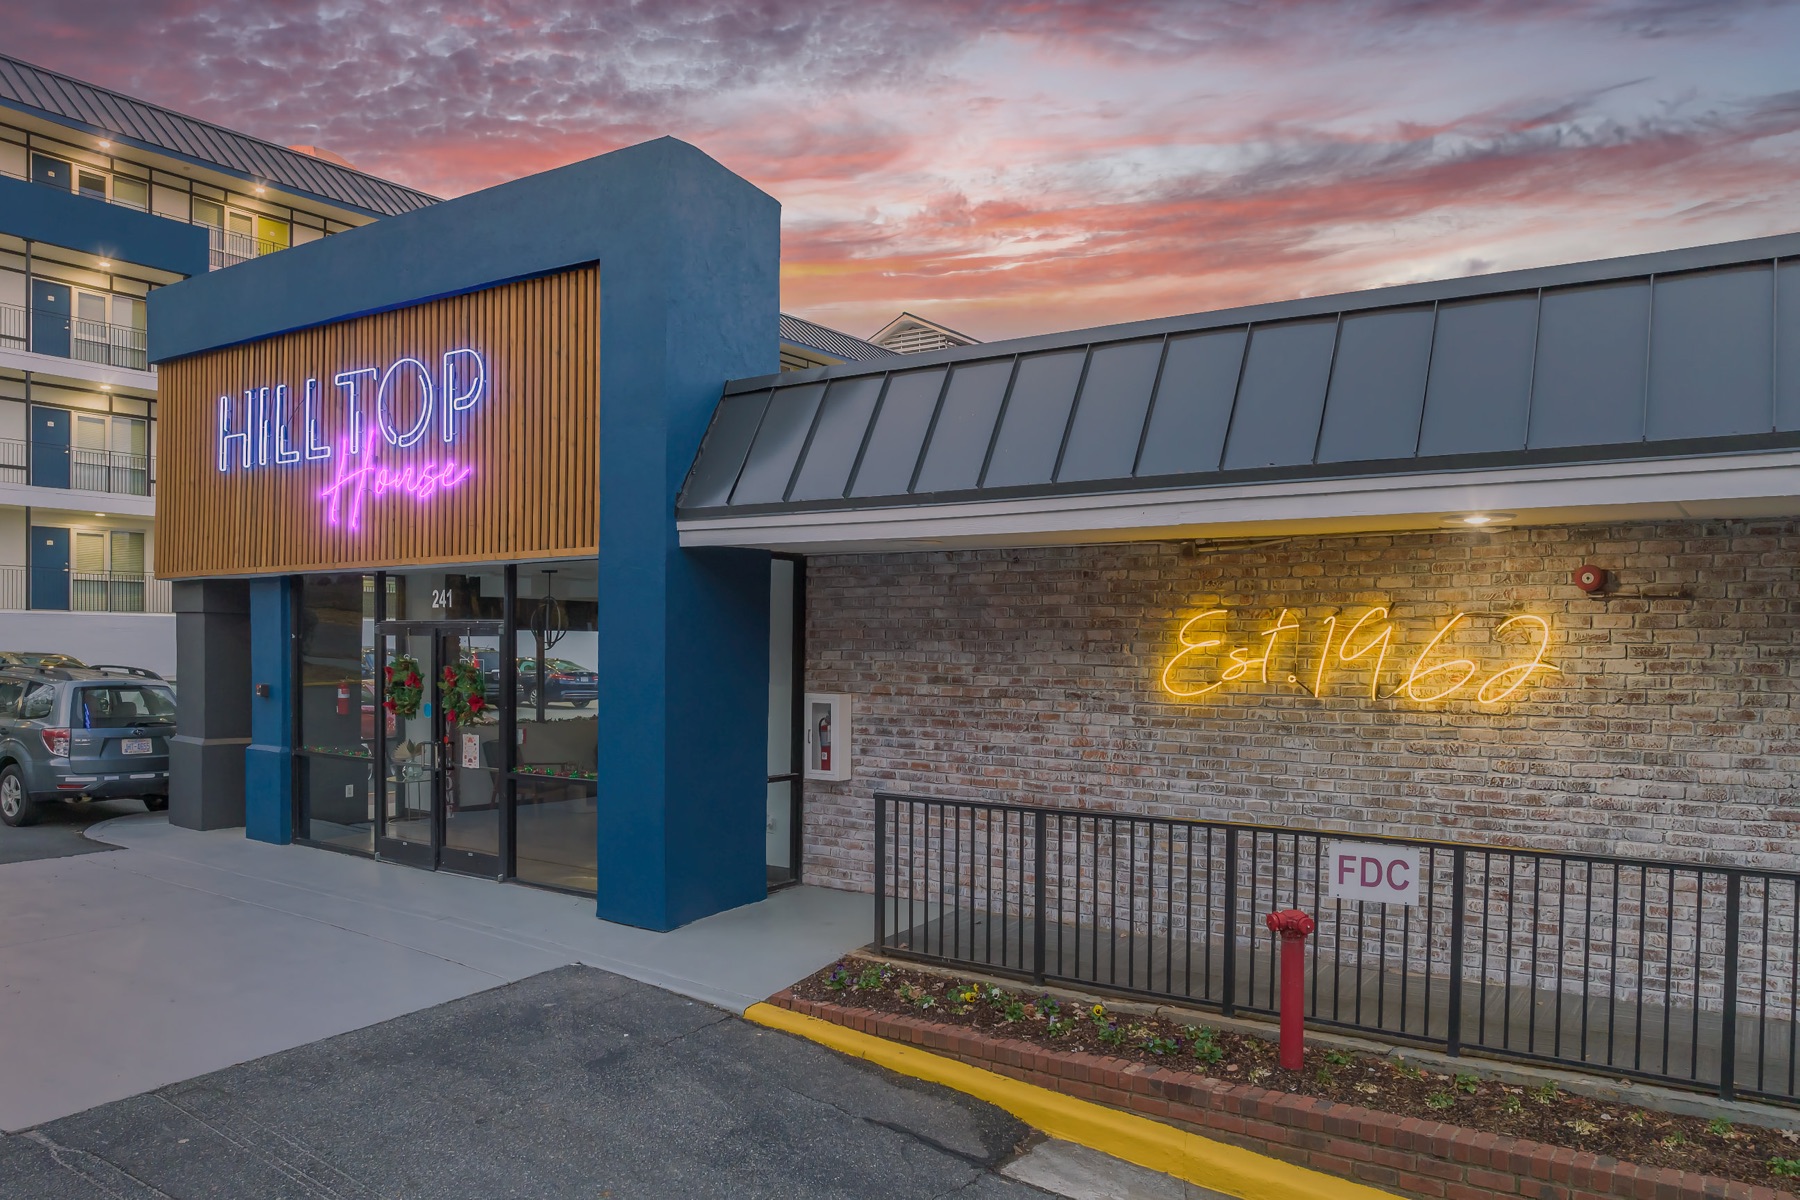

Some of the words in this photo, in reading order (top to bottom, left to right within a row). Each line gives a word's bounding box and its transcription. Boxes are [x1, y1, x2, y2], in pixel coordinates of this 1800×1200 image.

[218, 347, 485, 472] HILLTOP
[320, 428, 472, 529] House
[431, 588, 453, 609] 241
[1337, 853, 1411, 892] FDC
